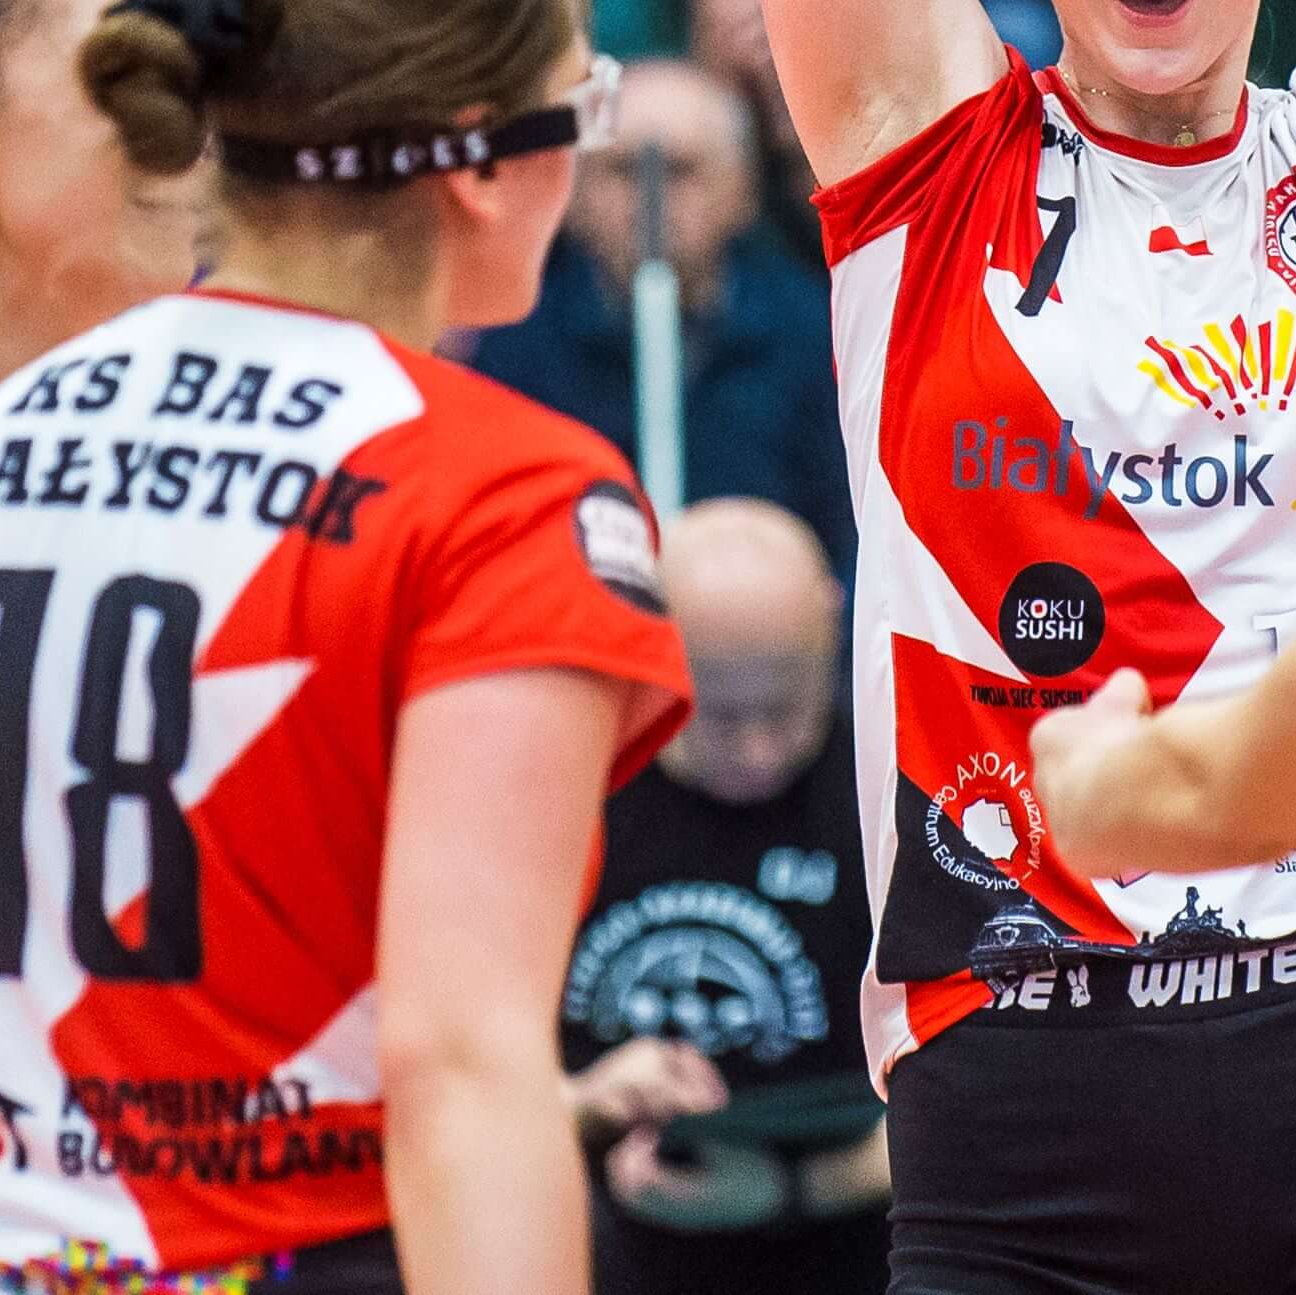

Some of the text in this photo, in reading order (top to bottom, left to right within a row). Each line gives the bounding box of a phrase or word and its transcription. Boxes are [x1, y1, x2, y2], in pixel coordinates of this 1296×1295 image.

[1015, 195, 1077, 317] 7
[155, 352, 343, 428] BAS
[953, 415, 1275, 520] Białystok
[1015, 619, 1084, 641] SUSHI
[1017, 598, 1085, 619] KOKU
[956, 752, 1027, 789] AXON
[925, 785, 958, 847] Centrum
[932, 844, 1020, 892] Edukacyjno
